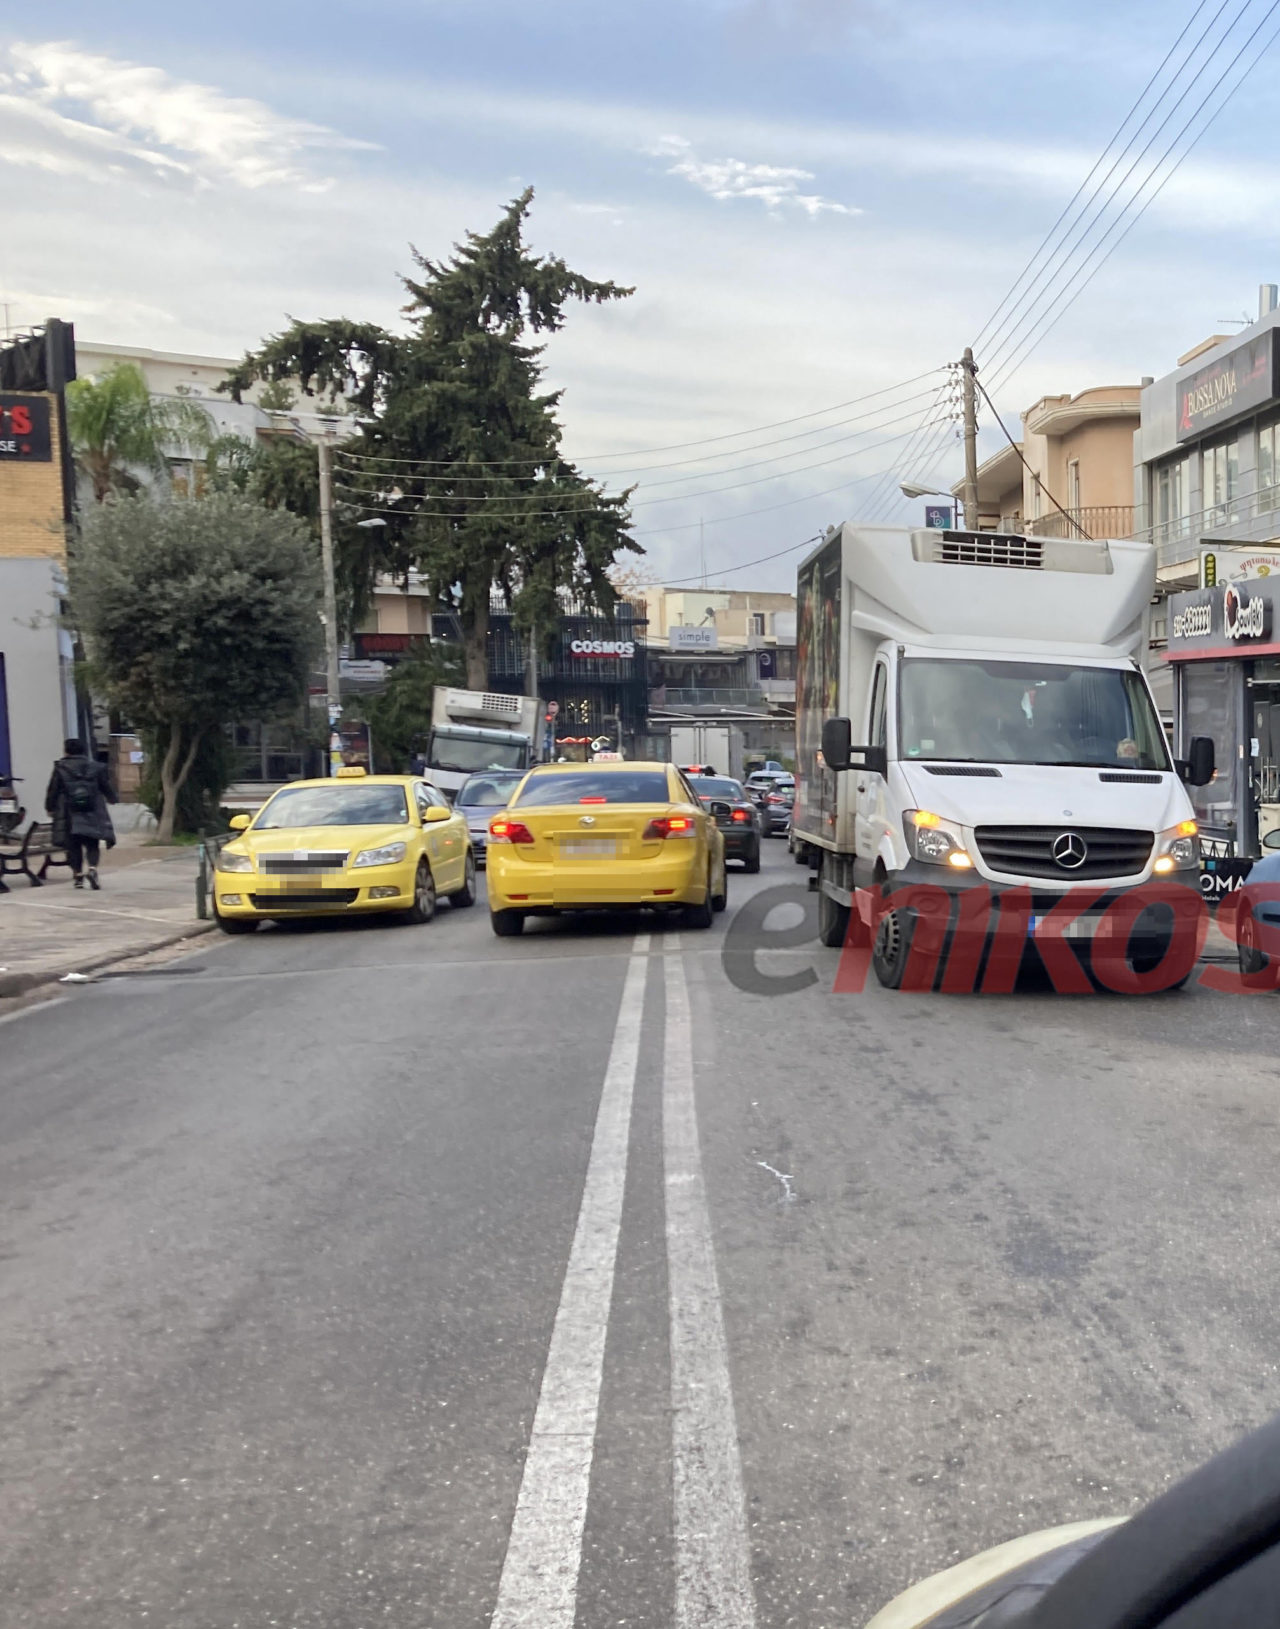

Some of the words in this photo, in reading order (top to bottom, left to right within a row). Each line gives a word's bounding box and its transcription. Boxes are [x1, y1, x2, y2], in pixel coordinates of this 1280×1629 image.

[1188, 380, 1214, 416] BOSSA
[1214, 369, 1237, 403] NOVA
[678, 631, 711, 644] simple
[571, 640, 635, 654] COSMOS
